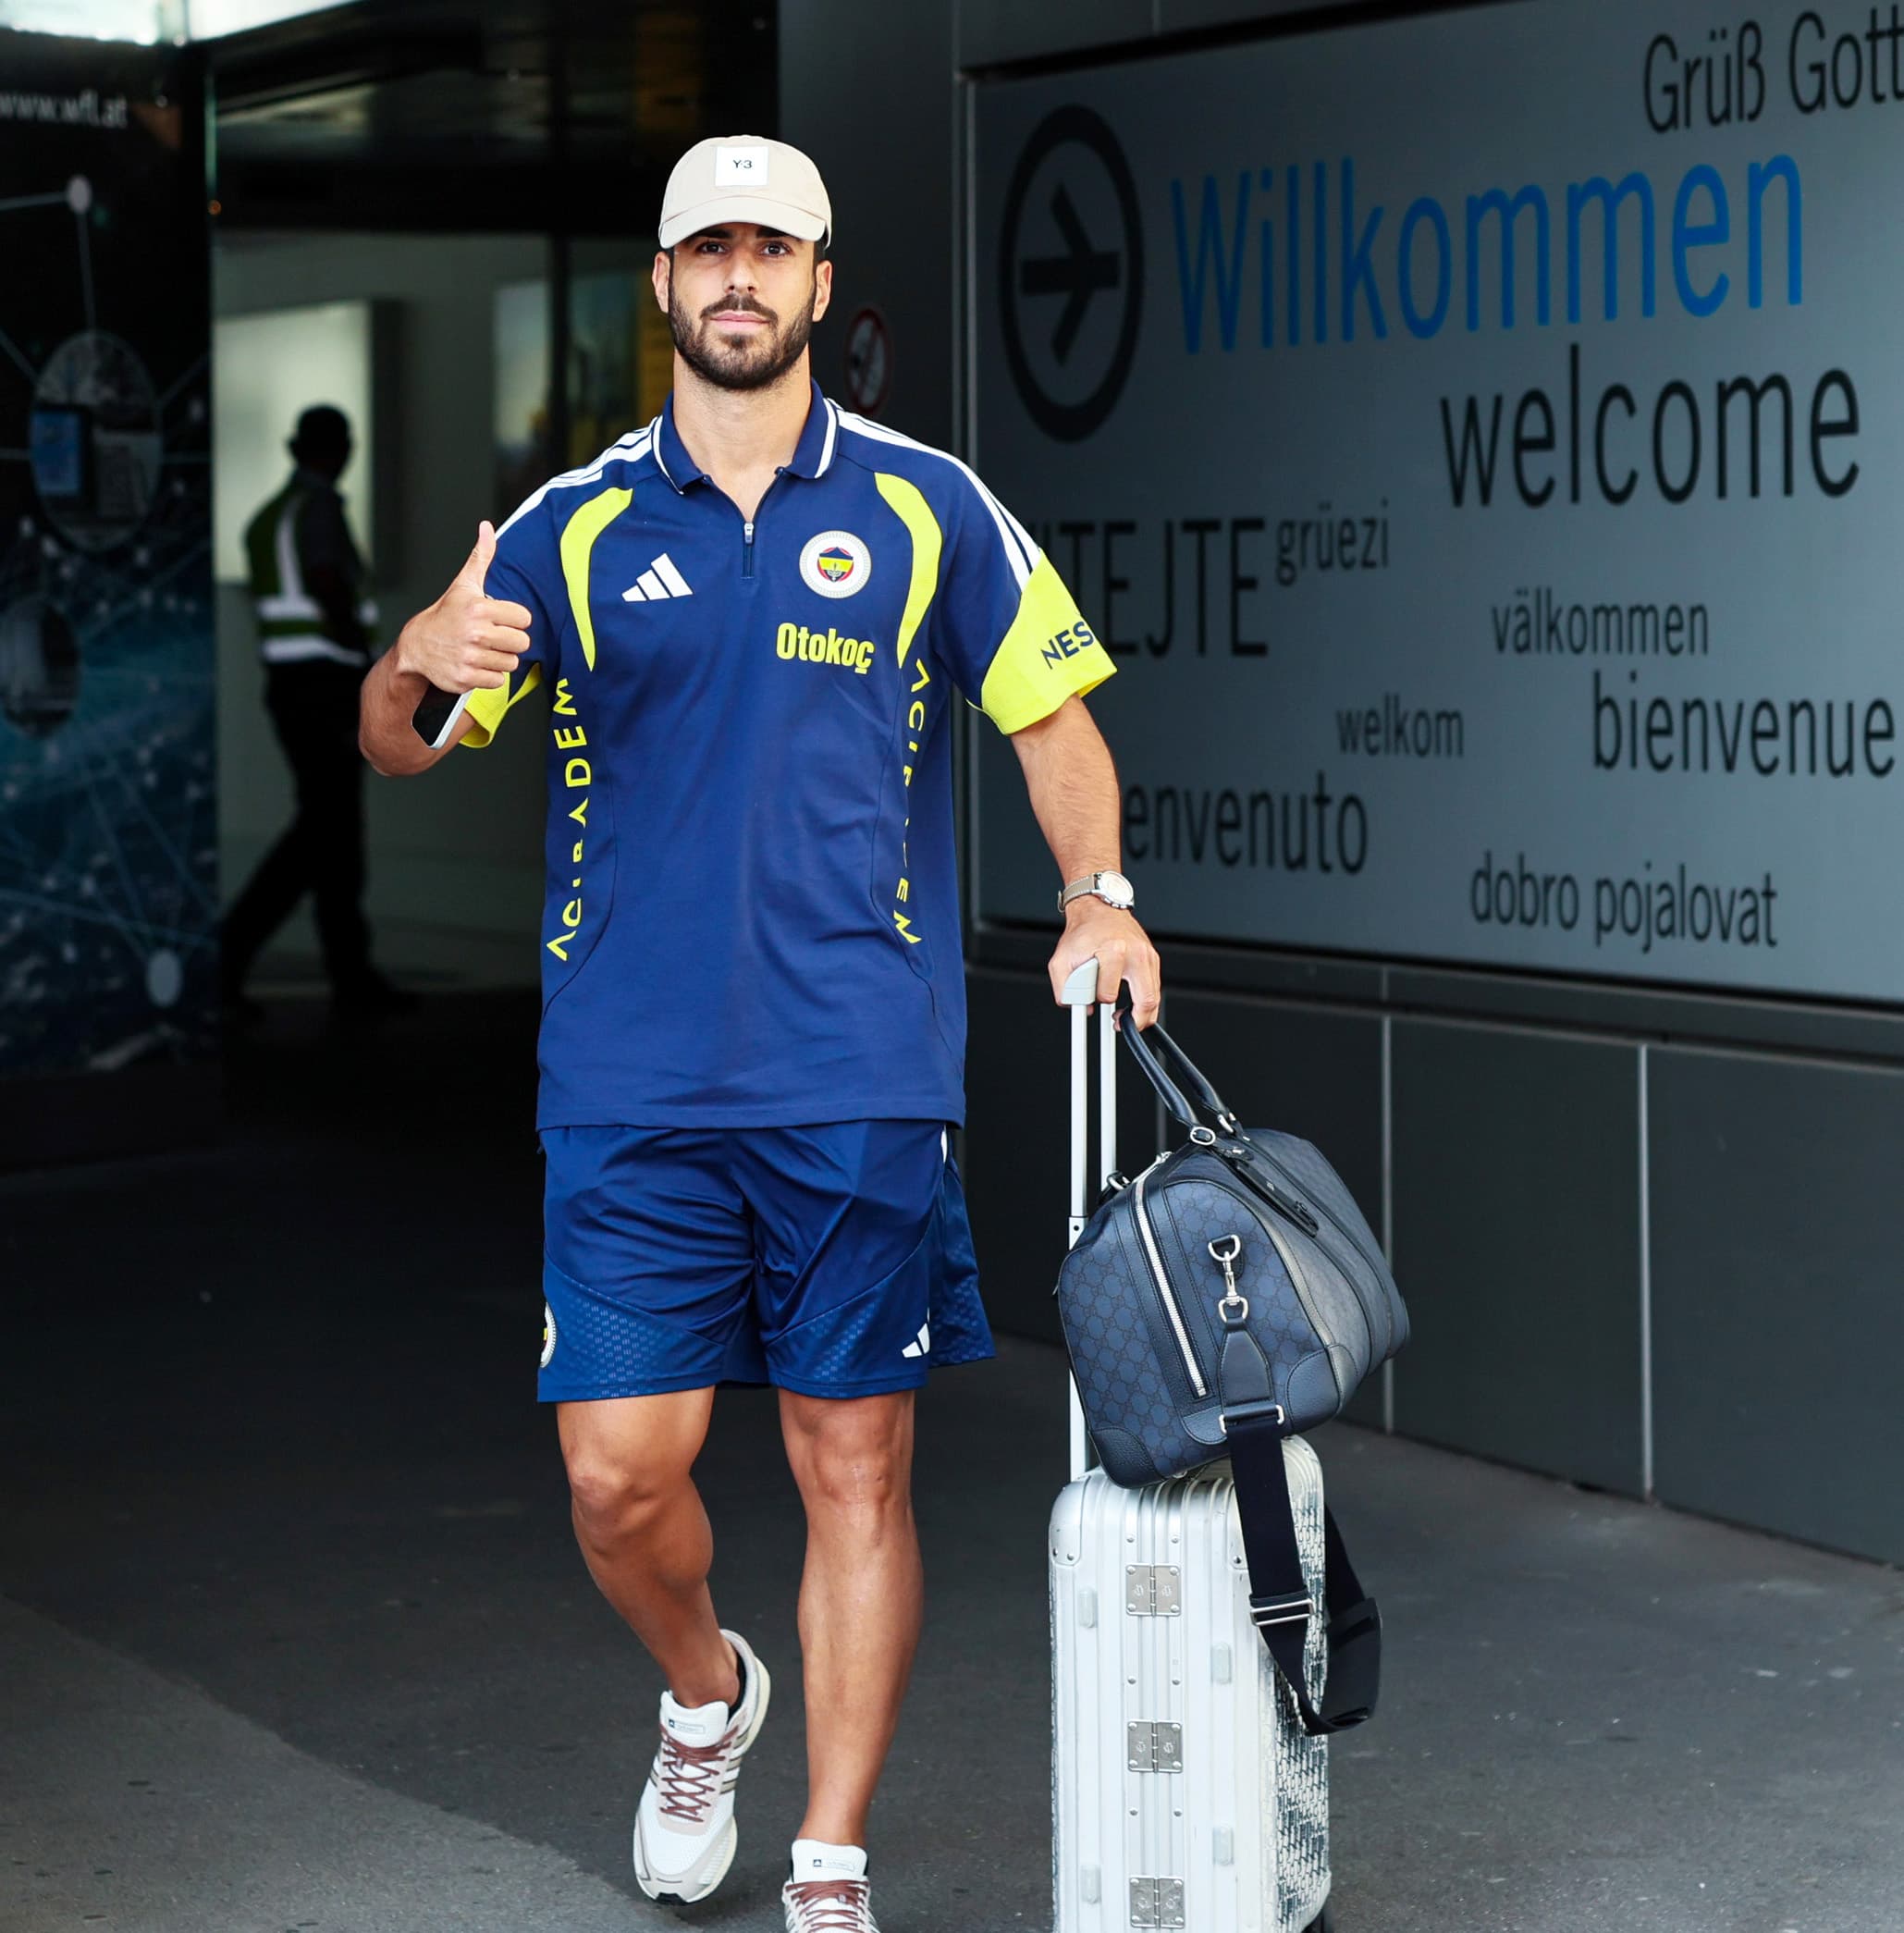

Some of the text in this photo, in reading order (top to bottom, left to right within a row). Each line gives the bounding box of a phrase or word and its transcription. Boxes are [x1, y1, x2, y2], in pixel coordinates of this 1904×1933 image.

[1643, 4, 1904, 134] Grüß Gott
[1171, 153, 1804, 355] Willkommen
[1441, 343, 1860, 508] welcome
[1030, 518, 1269, 658] TEJTE
[1275, 499, 1391, 587] grüezi
[776, 622, 875, 675] Otokoç
[1492, 588, 1710, 657] välkommen
[1336, 694, 1465, 759] welkom
[1594, 671, 1896, 780] bienvenue
[1123, 770, 1369, 877] envenuto
[1470, 851, 1779, 954] dobro pojalovat
